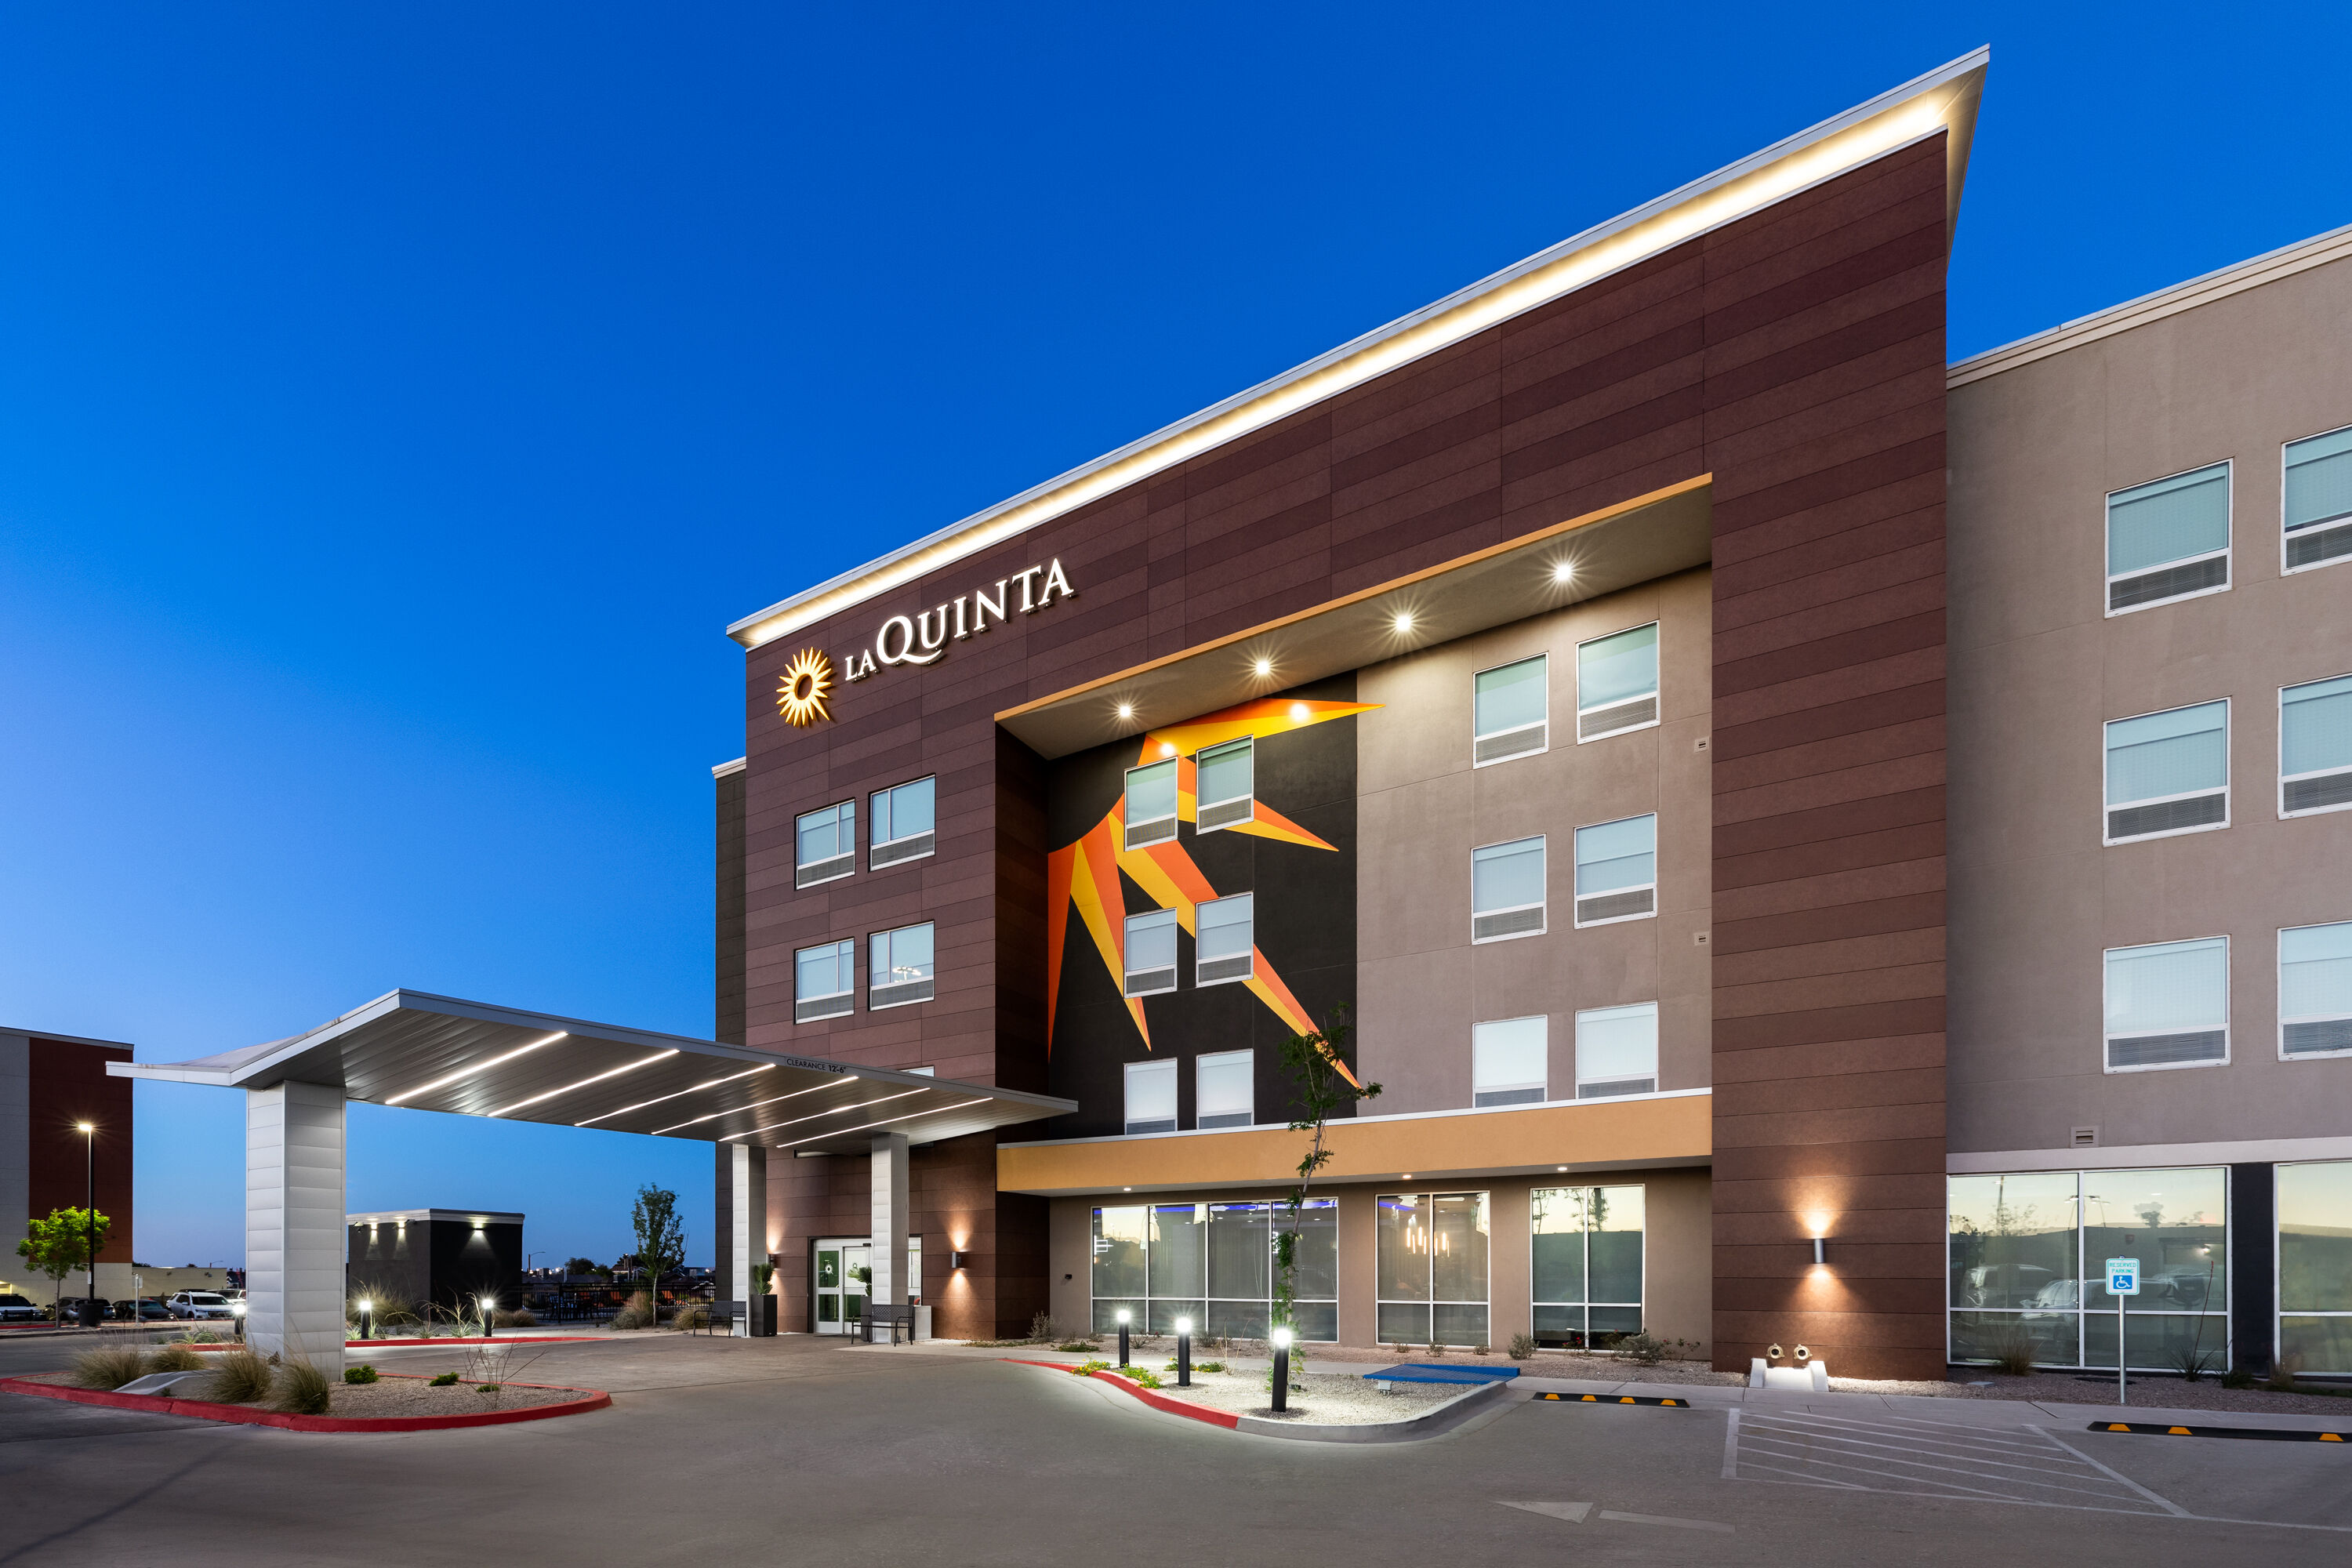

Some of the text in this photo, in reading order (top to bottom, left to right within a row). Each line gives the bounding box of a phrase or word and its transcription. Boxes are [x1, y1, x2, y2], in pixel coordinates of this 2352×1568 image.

[844, 557, 1074, 681] LA QUINTA
[786, 1058, 826, 1071] CLEARANCE
